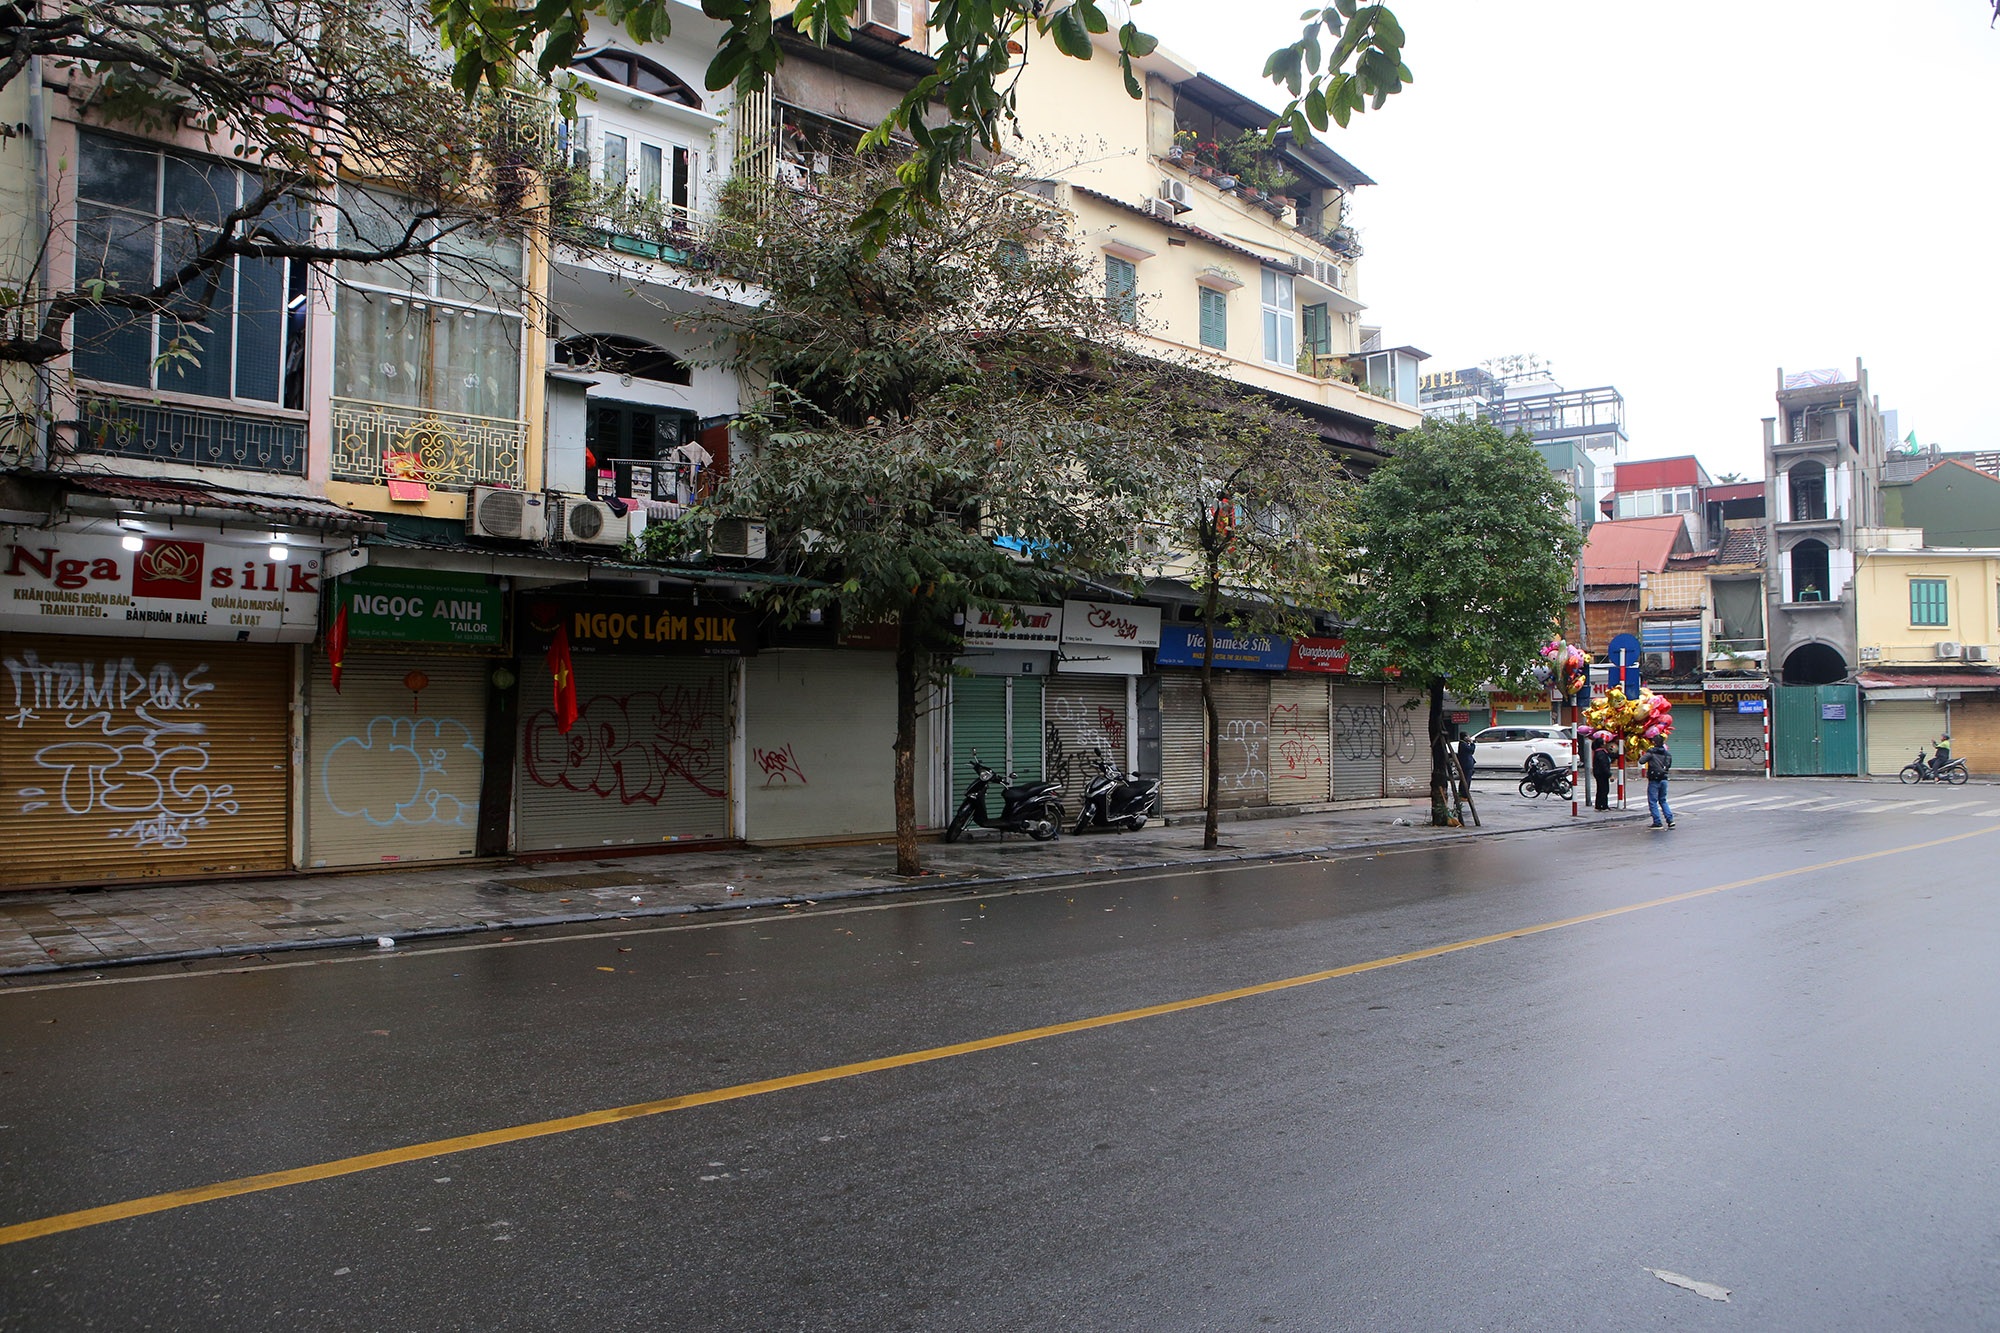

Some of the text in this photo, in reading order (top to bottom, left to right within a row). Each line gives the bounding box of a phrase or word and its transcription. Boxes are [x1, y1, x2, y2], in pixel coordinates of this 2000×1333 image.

[4, 544, 319, 593] Nga silk
[40, 604, 102, 618] TRANH THÊU
[352, 594, 482, 622] NGỌC ANH
[146, 610, 172, 623] BUÔN
[1088, 604, 1138, 639] Cherry
[449, 622, 488, 633] TAILOR
[575, 610, 737, 645] NGỌC LÂM SILK
[1250, 638, 1272, 652] Silk
[1712, 692, 1734, 703] ĐỨC
[1737, 693, 1765, 701] LONG
